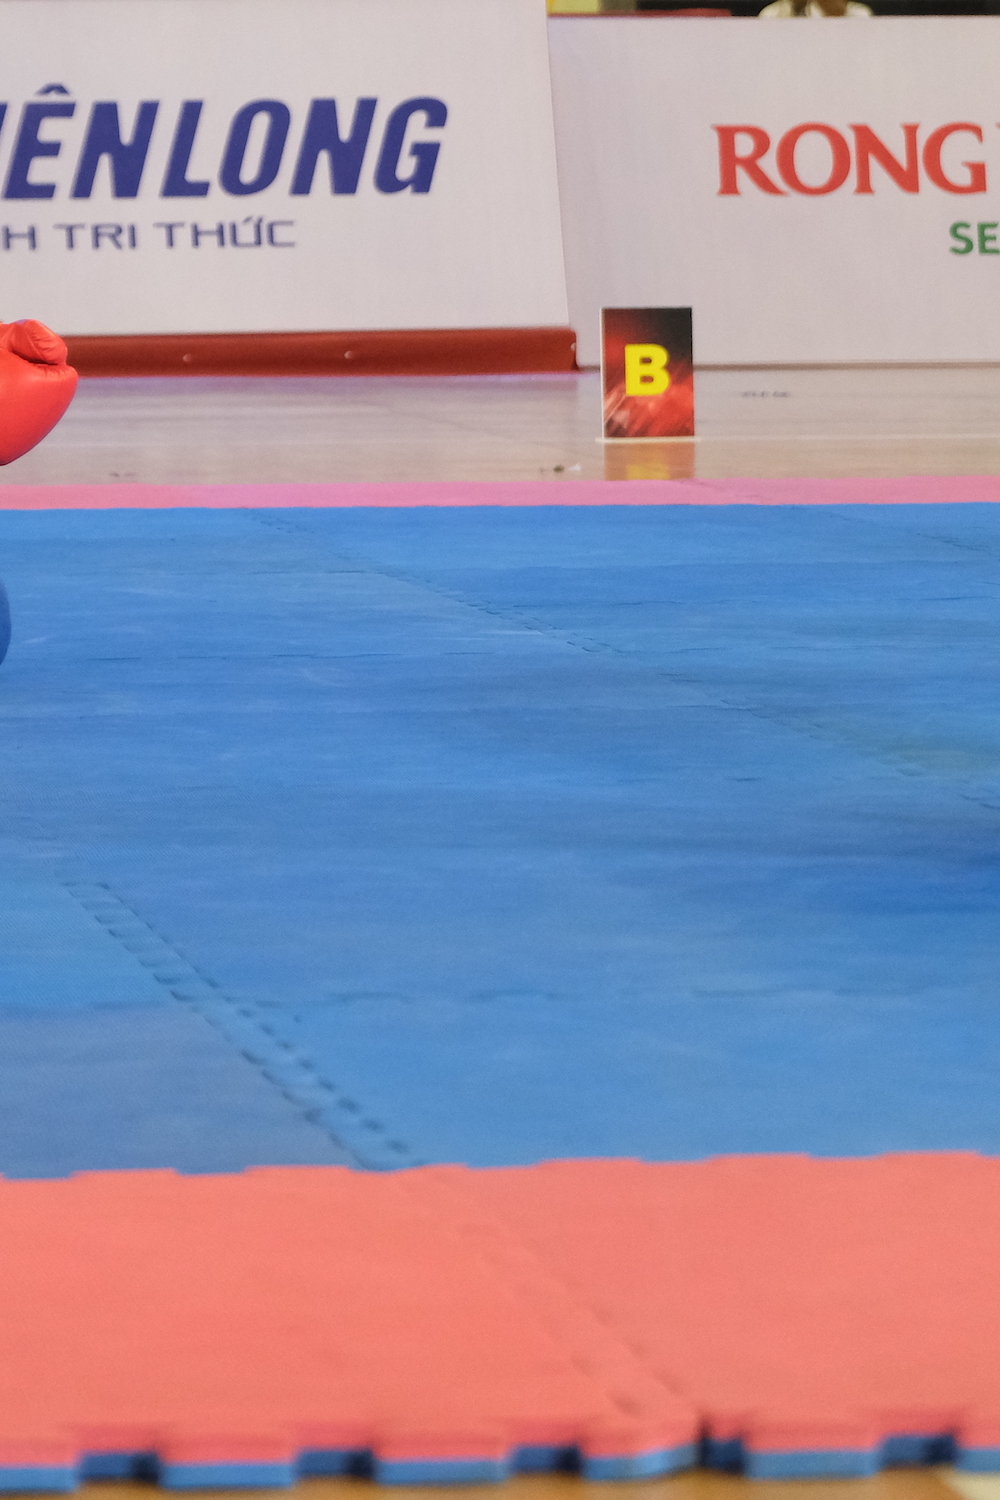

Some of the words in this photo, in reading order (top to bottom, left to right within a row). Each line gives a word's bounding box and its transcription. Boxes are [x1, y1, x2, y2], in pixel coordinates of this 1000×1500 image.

[711, 122, 988, 197] RONG
[52, 222, 138, 251] TRI
[153, 215, 297, 250] THỨC
[624, 343, 670, 397] B
